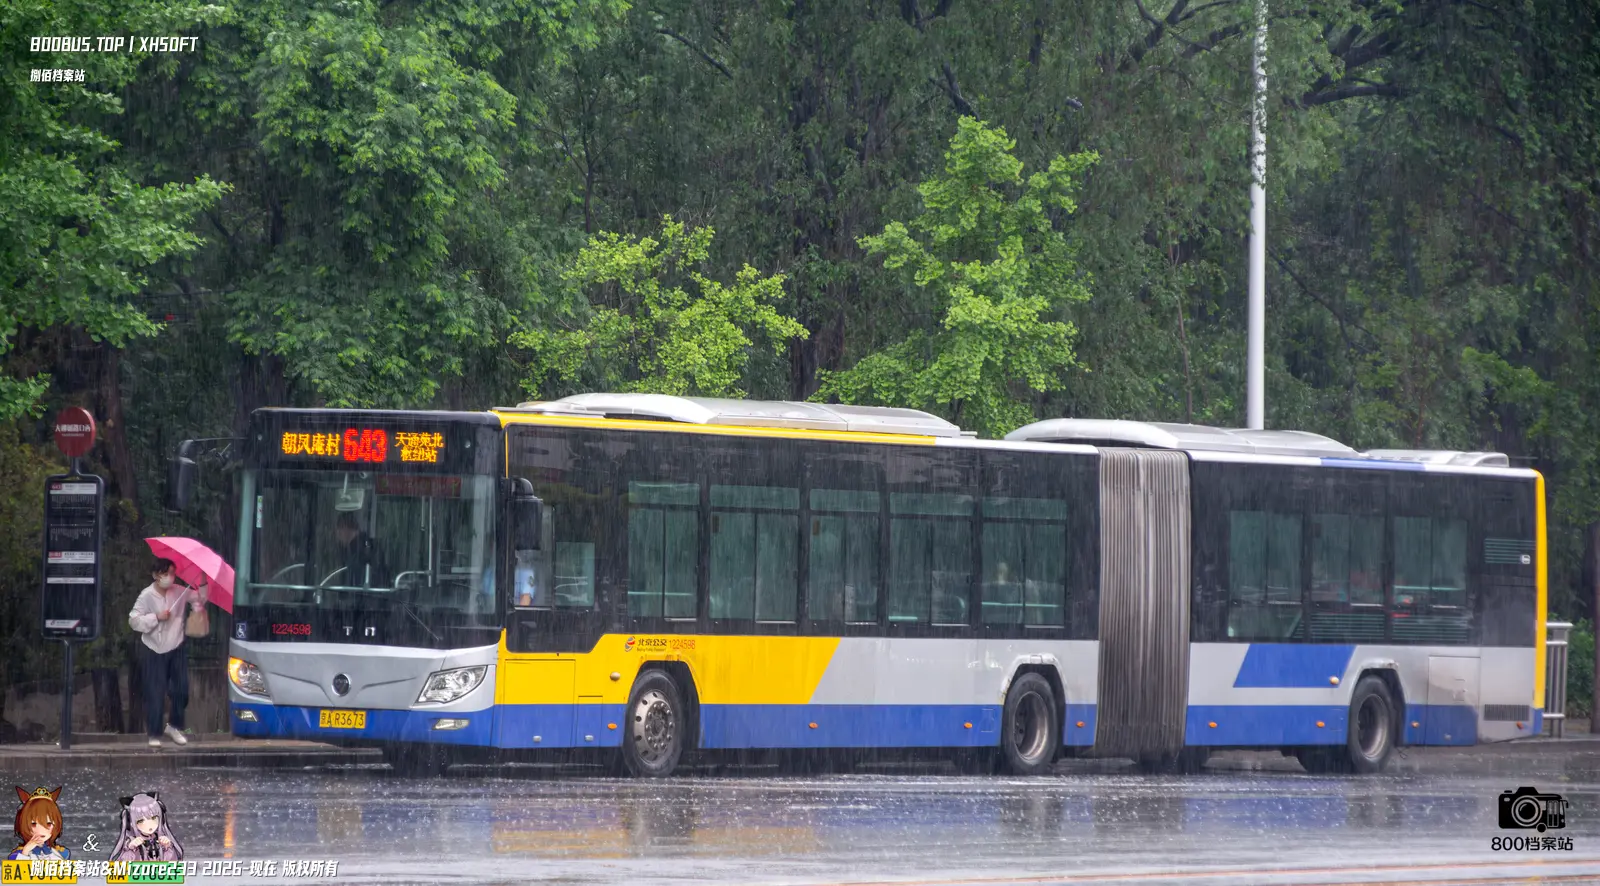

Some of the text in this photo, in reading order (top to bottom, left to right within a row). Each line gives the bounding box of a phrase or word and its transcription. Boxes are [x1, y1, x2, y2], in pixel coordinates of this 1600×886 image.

[282, 428, 387, 462] 朝凤庵村 643
[394, 432, 444, 447] 天通苑北
[271, 623, 312, 635] 1224598
[638, 638, 667, 646] 北京公交
[669, 639, 696, 650] 1224598
